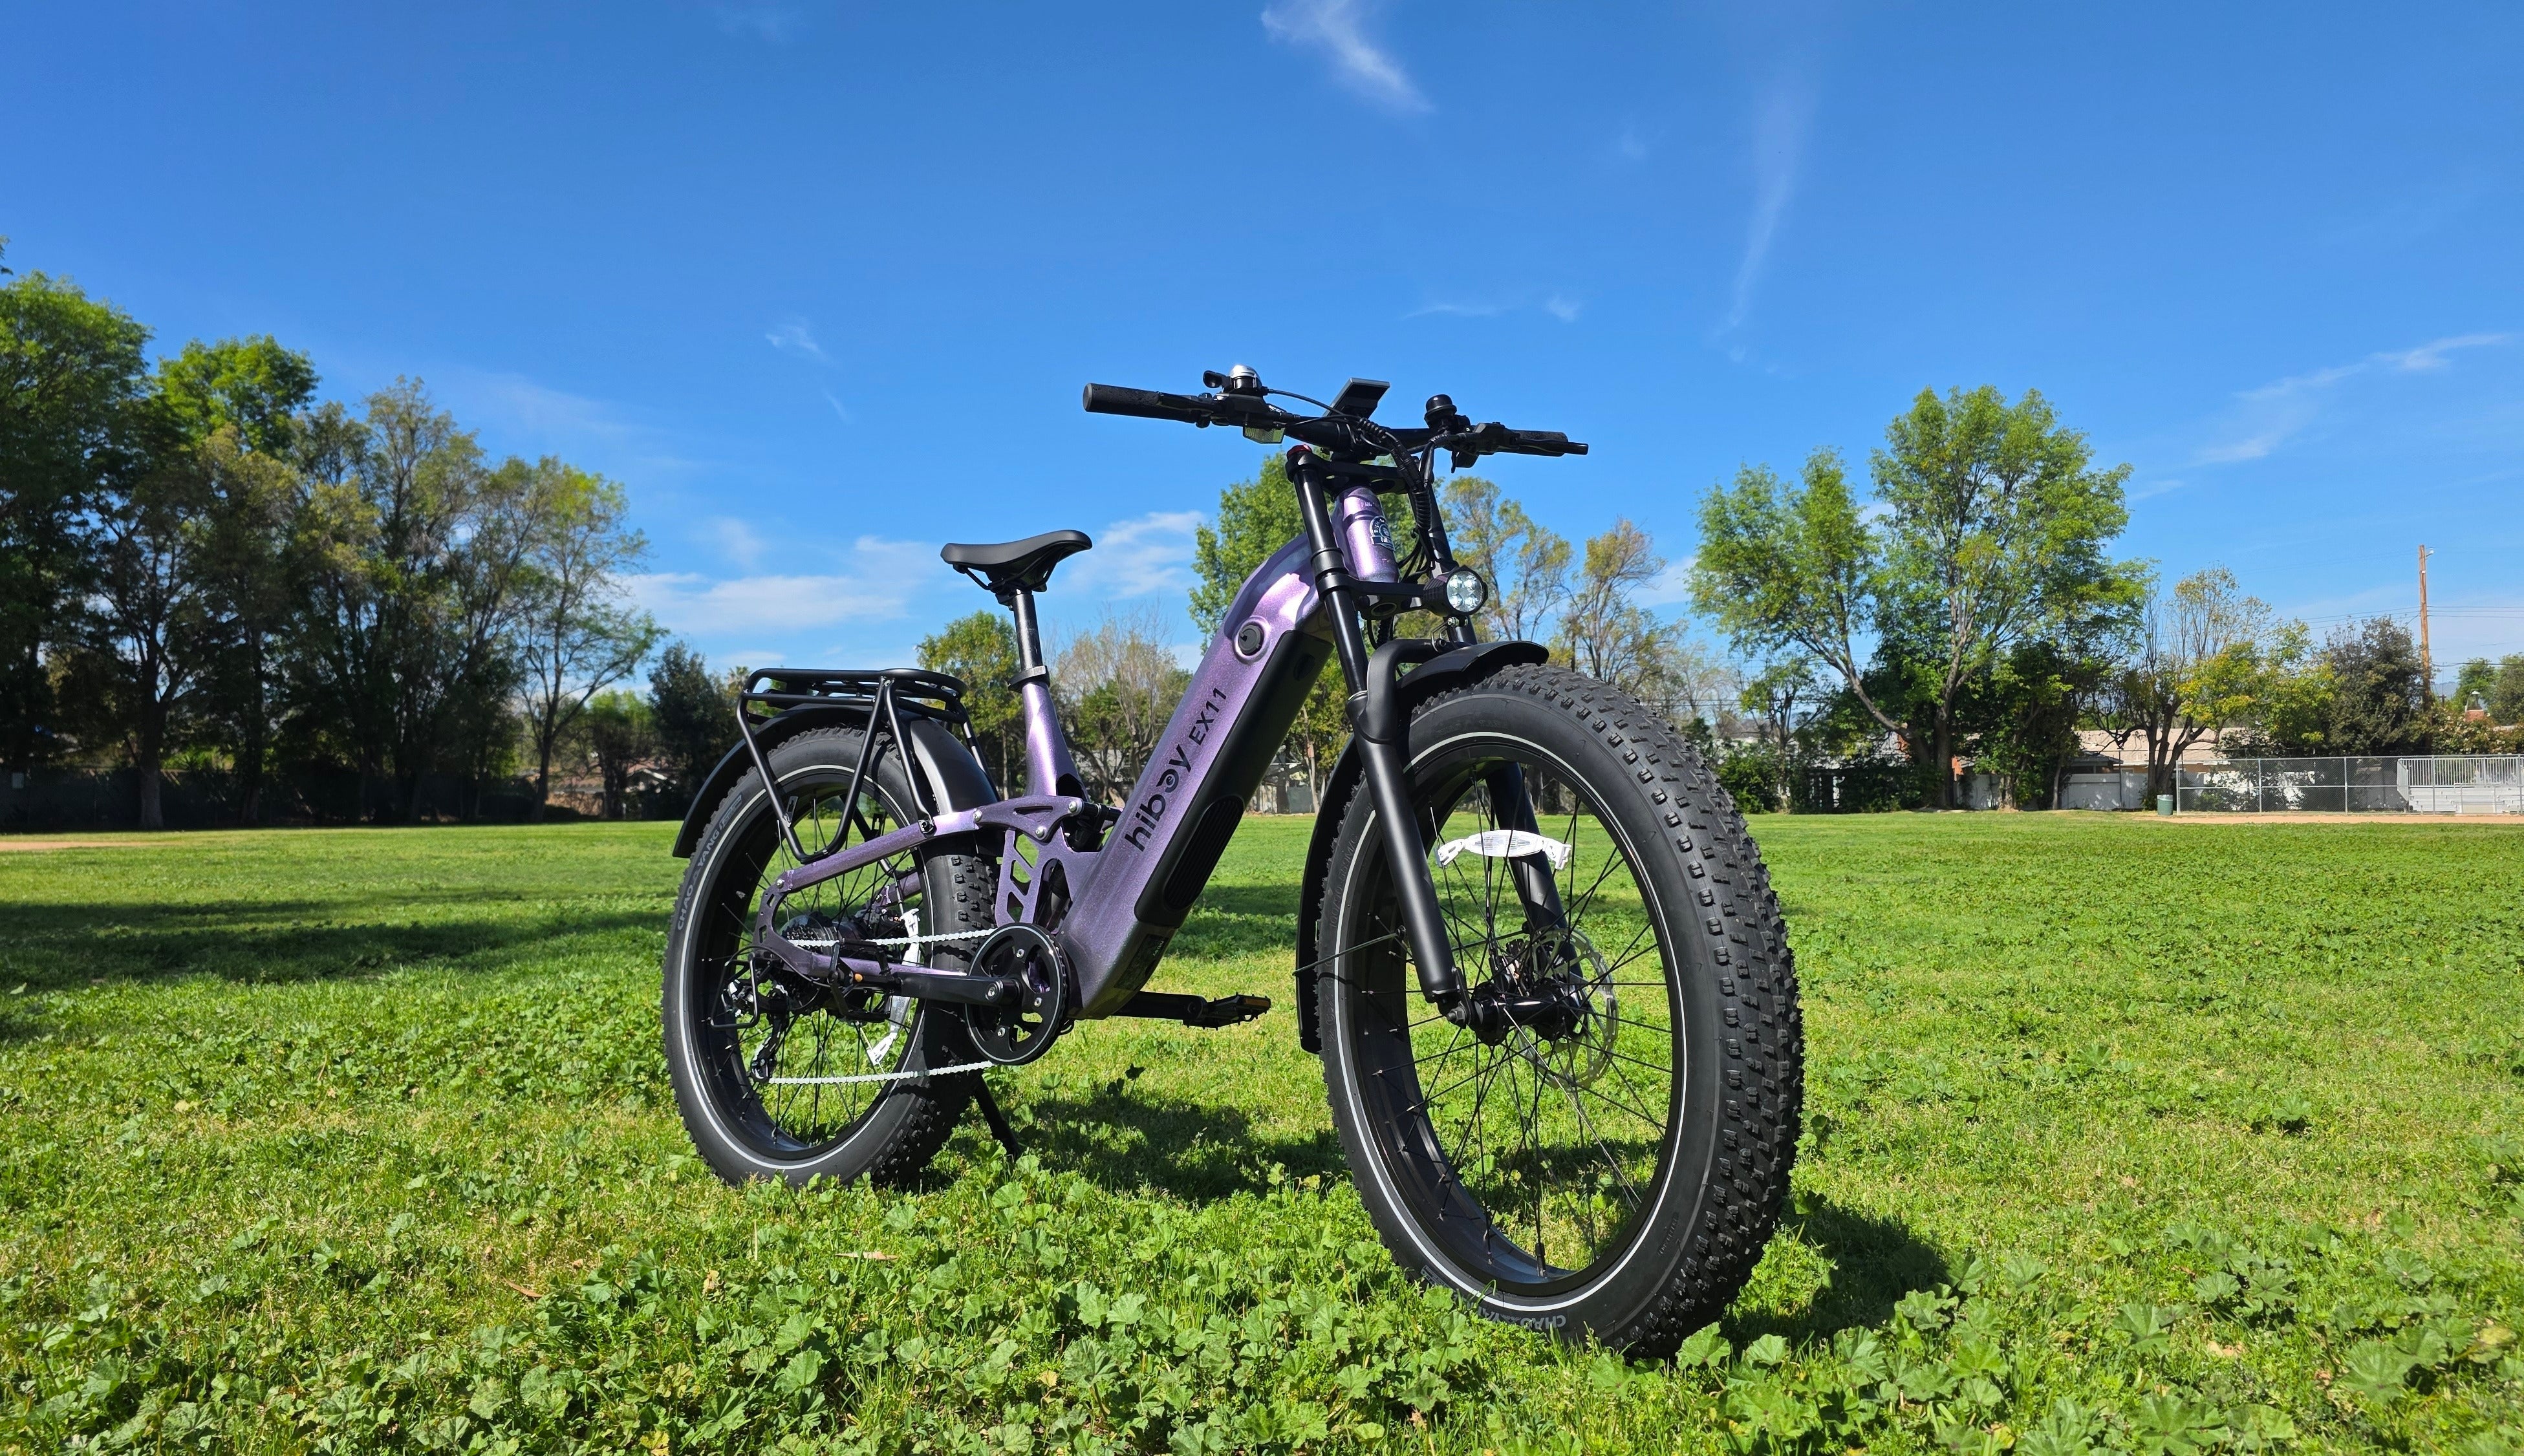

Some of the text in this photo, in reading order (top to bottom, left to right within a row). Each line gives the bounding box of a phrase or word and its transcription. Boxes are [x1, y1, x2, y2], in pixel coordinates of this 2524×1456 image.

[1124, 687, 1227, 852] hiboy EX11
[677, 828, 720, 930] CHAO YANG
